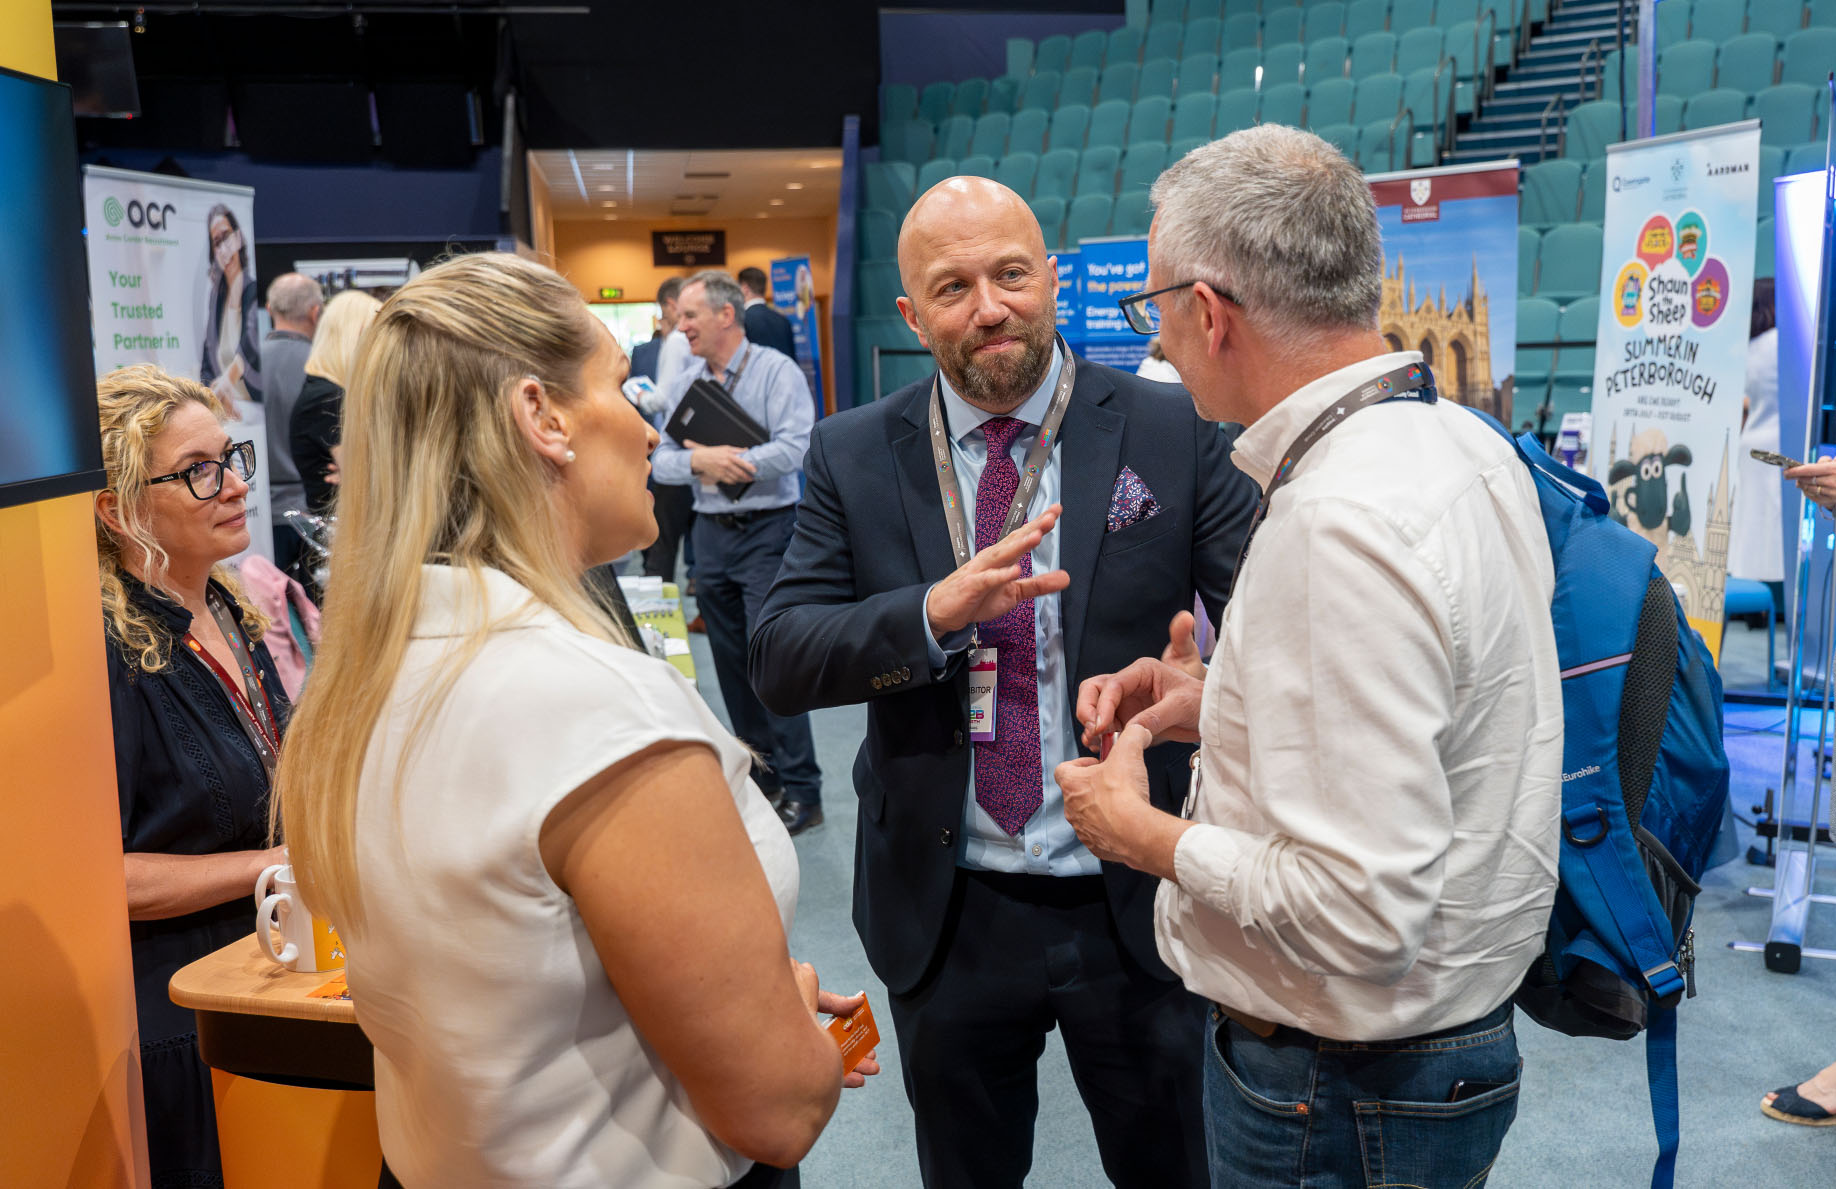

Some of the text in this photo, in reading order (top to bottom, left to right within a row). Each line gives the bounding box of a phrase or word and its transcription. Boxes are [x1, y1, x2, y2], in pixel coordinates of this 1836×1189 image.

[1087, 260, 1146, 278] You've got
[109, 271, 142, 288] Your
[1087, 281, 1107, 293] the
[1649, 274, 1688, 301] Shaun
[111, 302, 163, 319] Trusted
[1086, 306, 1119, 320] Energy
[1649, 302, 1686, 325] Sheep
[114, 332, 180, 350] Partner in
[1625, 334, 1699, 364] SUMMER IN
[1605, 362, 1716, 404] PETERBOROUGH
[1563, 765, 1601, 781] Eurohike
